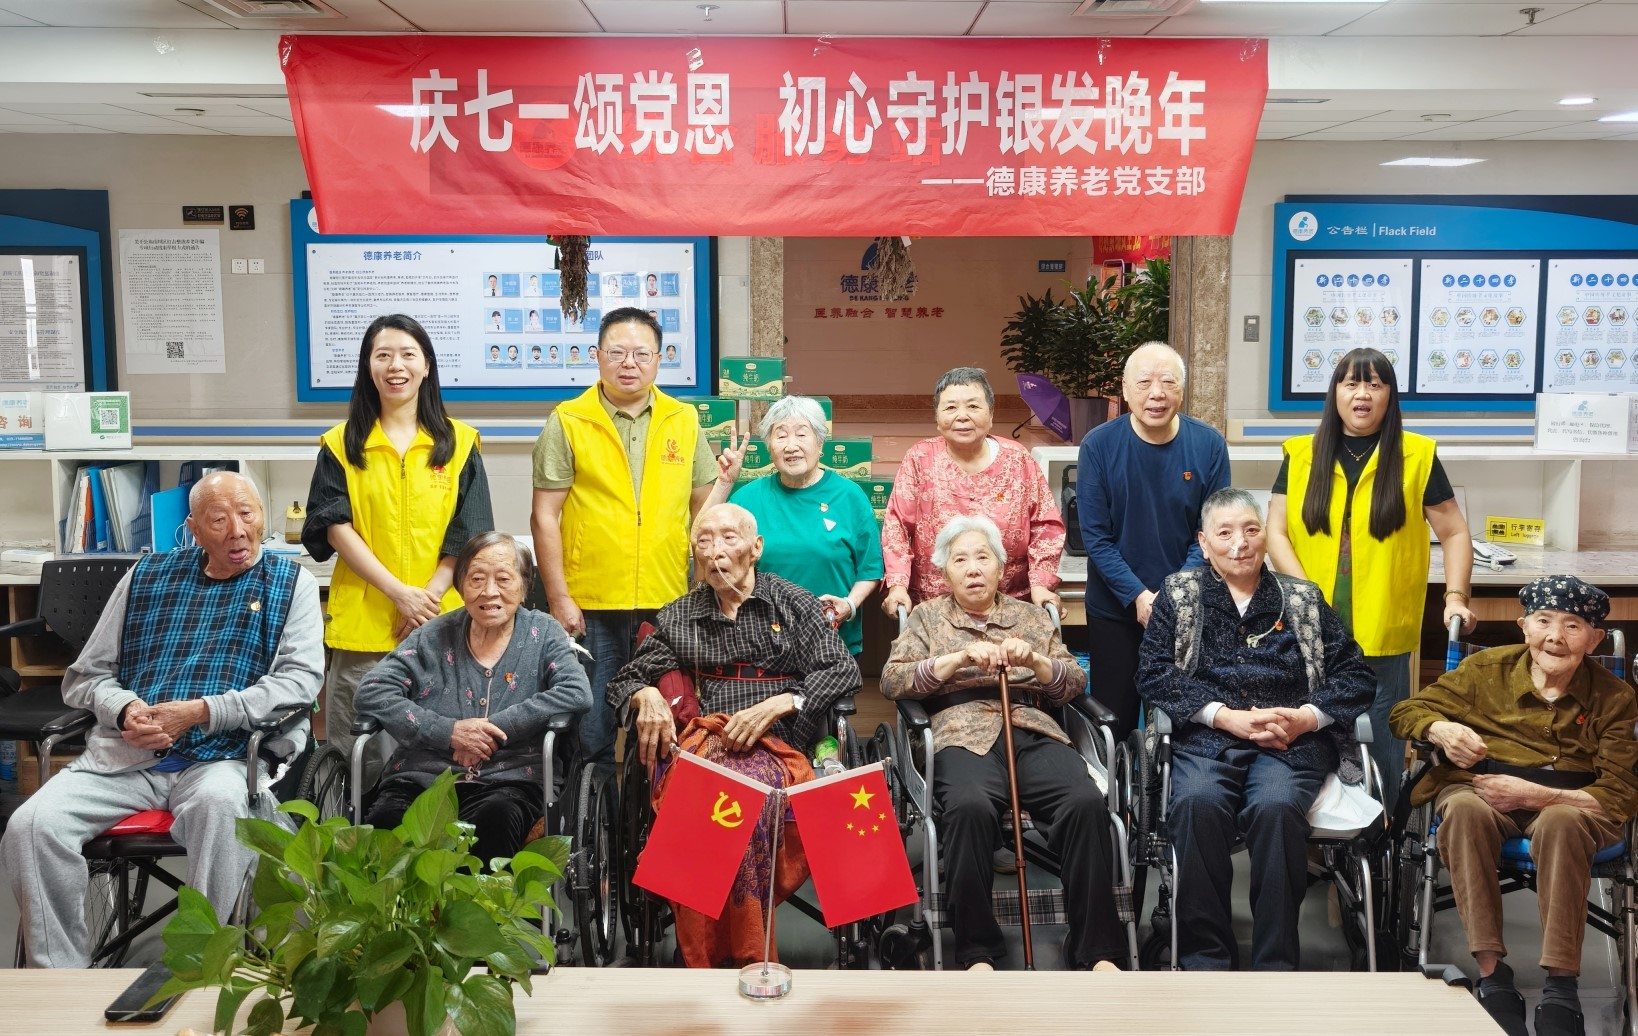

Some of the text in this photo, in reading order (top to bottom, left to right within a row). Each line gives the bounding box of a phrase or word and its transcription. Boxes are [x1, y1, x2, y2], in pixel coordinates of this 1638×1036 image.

[411, 71, 734, 154] 庆七一颂党恩
[779, 71, 1206, 155] 初心守护银发晚年
[1326, 226, 1436, 236] 公告栏 Flack Field
[363, 251, 422, 261] 德康养老简介
[1442, 275, 1517, 287] 新二十四孝
[814, 307, 945, 319] 医养融合 智慧养老
[742, 373, 760, 382] 纯牛奶
[831, 454, 849, 464] 纯牛奶
[1511, 524, 1541, 532] 行李寄存
